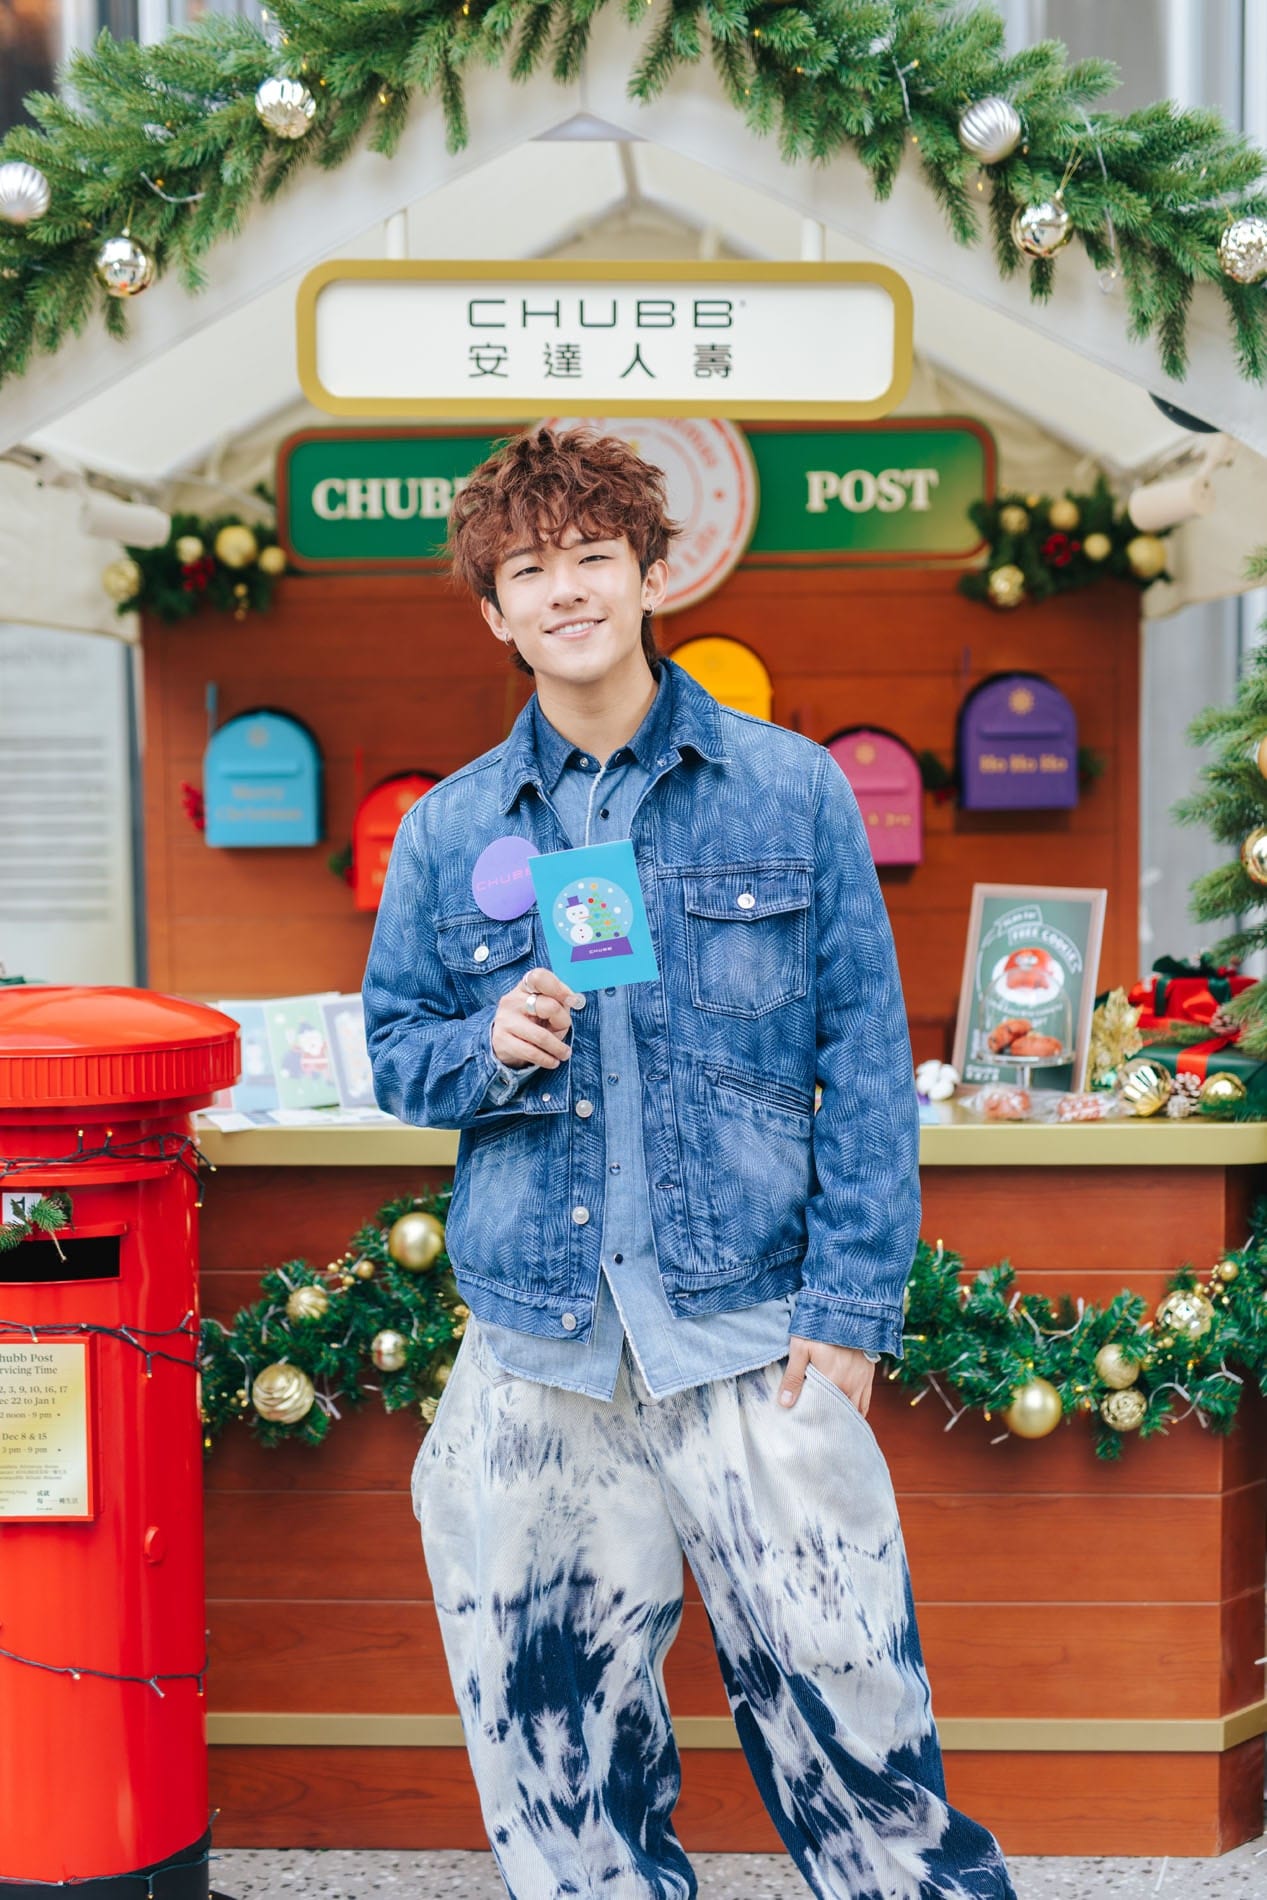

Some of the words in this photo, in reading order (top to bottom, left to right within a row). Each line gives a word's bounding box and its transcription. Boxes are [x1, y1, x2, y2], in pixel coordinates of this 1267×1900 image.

[469, 299, 733, 328] CHUBB
[468, 342, 732, 378] 安達人壽
[805, 468, 939, 513] POST
[588, 946, 613, 955] CHUBB
[31, 1353, 54, 1363] Post
[35, 1366, 58, 1375] Time
[30, 1386, 42, 1394] 10,
[45, 1386, 57, 1394] 16,
[11, 1397, 22, 1405] 22
[35, 1397, 50, 1406] Jan
[2, 1432, 19, 1440] Dec
[8, 1447, 22, 1455] pm
[35, 1447, 48, 1455] pm
